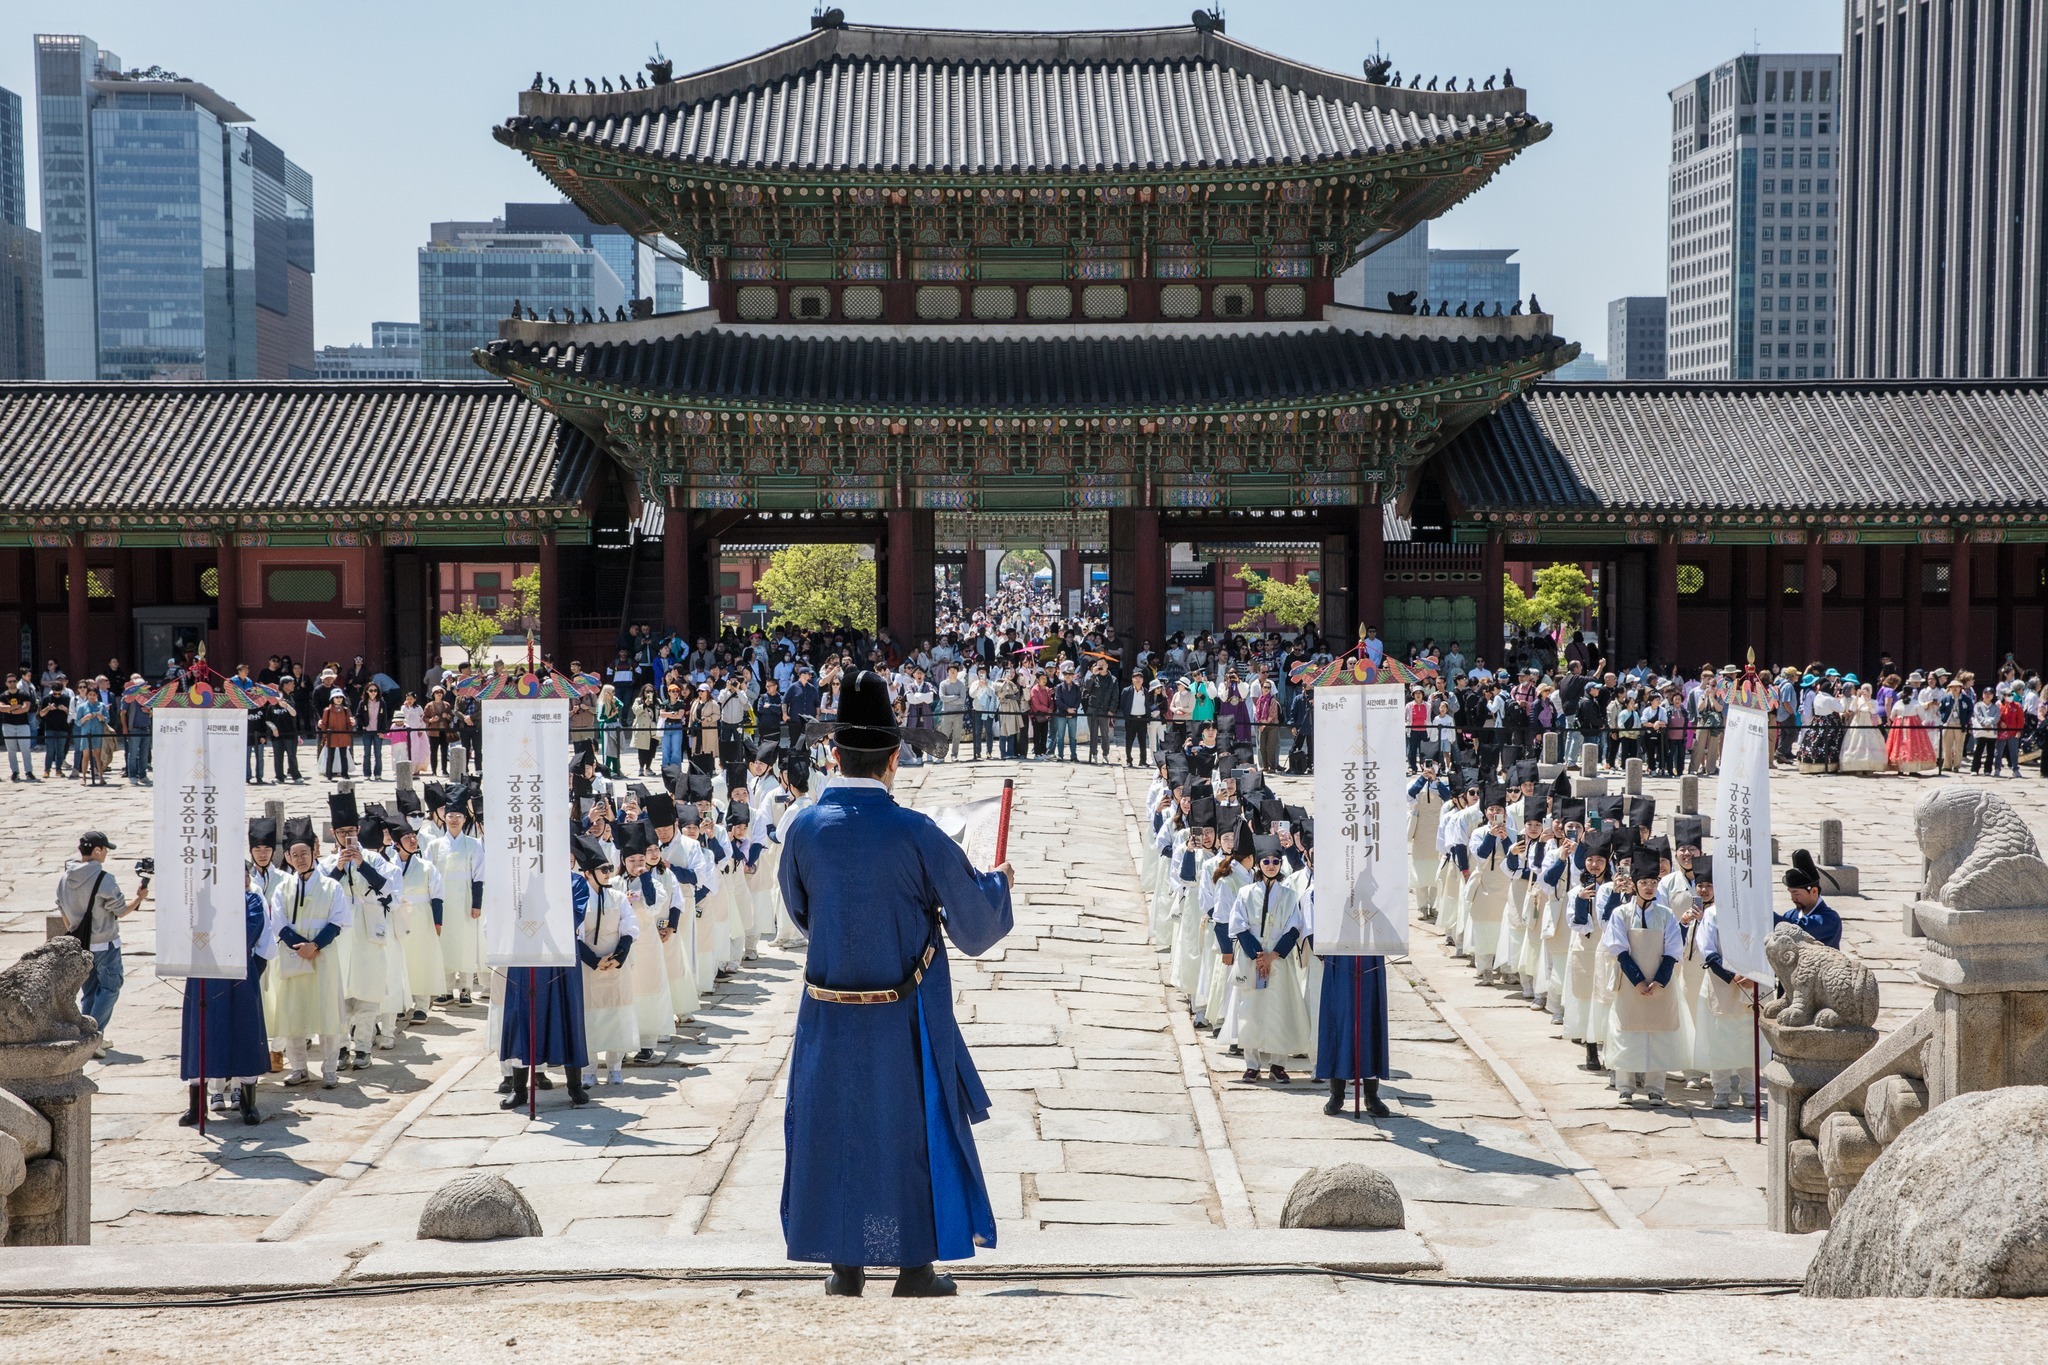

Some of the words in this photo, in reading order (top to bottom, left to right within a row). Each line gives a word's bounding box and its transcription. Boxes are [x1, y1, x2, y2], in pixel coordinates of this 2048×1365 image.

[179, 785, 198, 864] 궁중무용
[201, 785, 219, 885] 궁중새내기
[507, 774, 526, 853] 궁중병과
[527, 774, 544, 873] 궁중새내기
[1341, 761, 1359, 842] 궁중공예
[1362, 761, 1380, 862] 궁중새내기
[1727, 783, 1740, 863] 궁중회화
[1740, 786, 1753, 888] 궁중새내기
